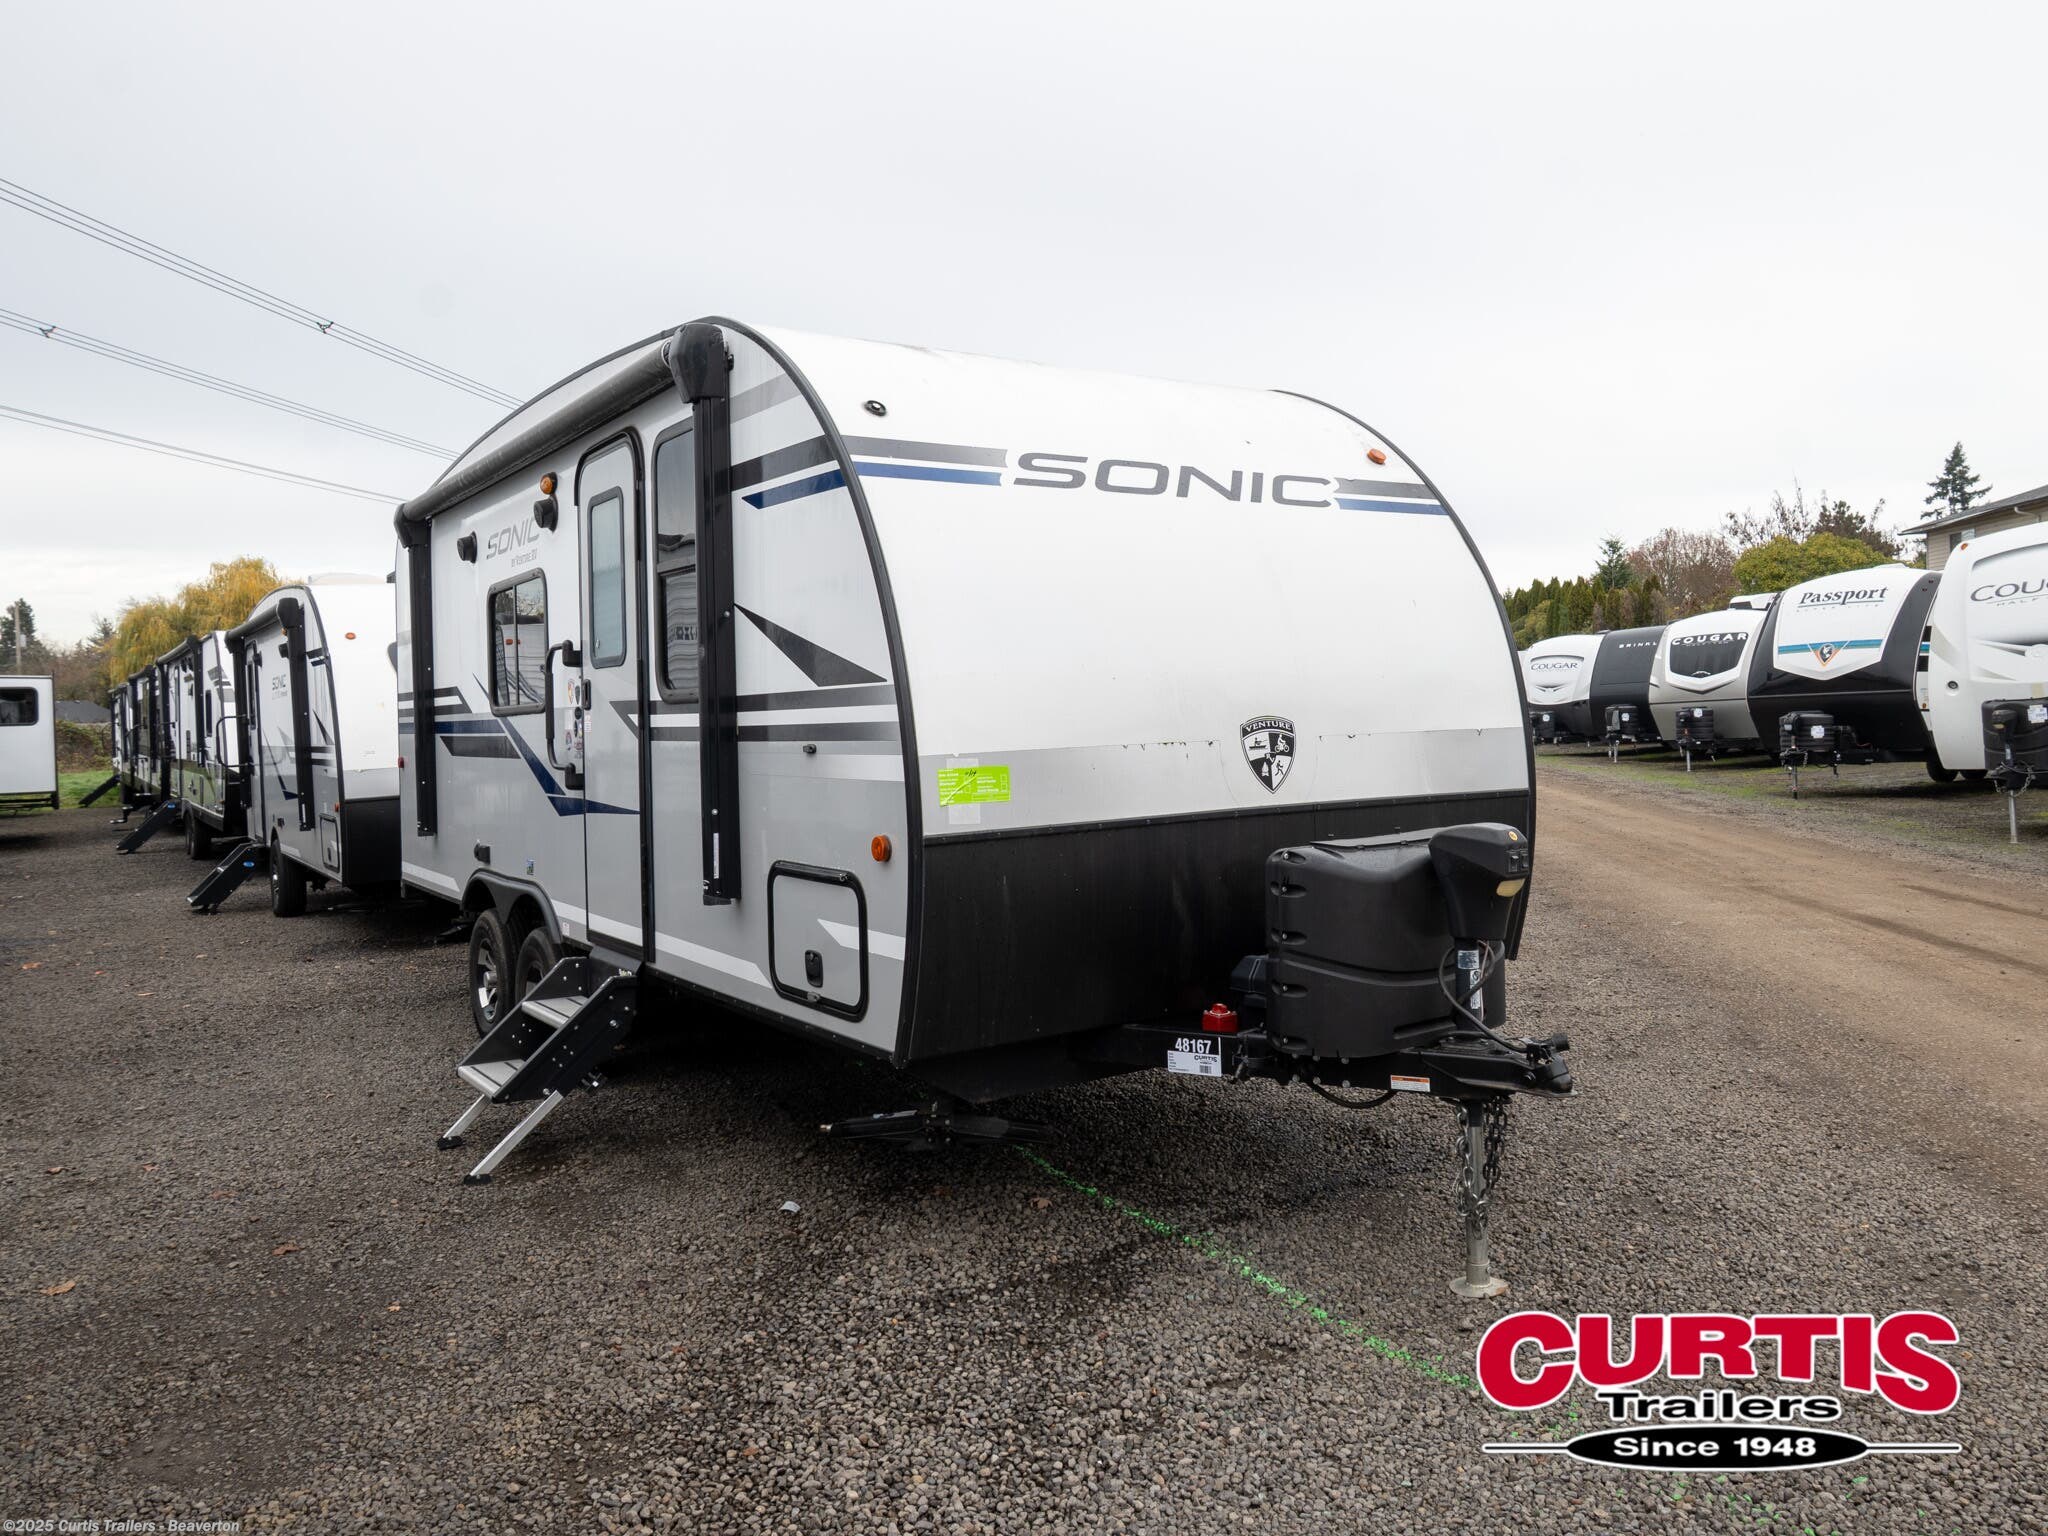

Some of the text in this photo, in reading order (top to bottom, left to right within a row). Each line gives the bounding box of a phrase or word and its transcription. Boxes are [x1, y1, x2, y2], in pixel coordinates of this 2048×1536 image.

[1014, 452, 1332, 507] SONIC
[486, 517, 539, 560] SONIC
[1799, 586, 1888, 606] Passport
[1970, 578, 2048, 602] COU
[1671, 632, 1747, 646] COUGAR
[1531, 662, 1578, 671] COUGAR
[1245, 720, 1292, 732] VENTURE
[1175, 1037, 1212, 1054] 48167
[1193, 1054, 1218, 1063] CURTIS
